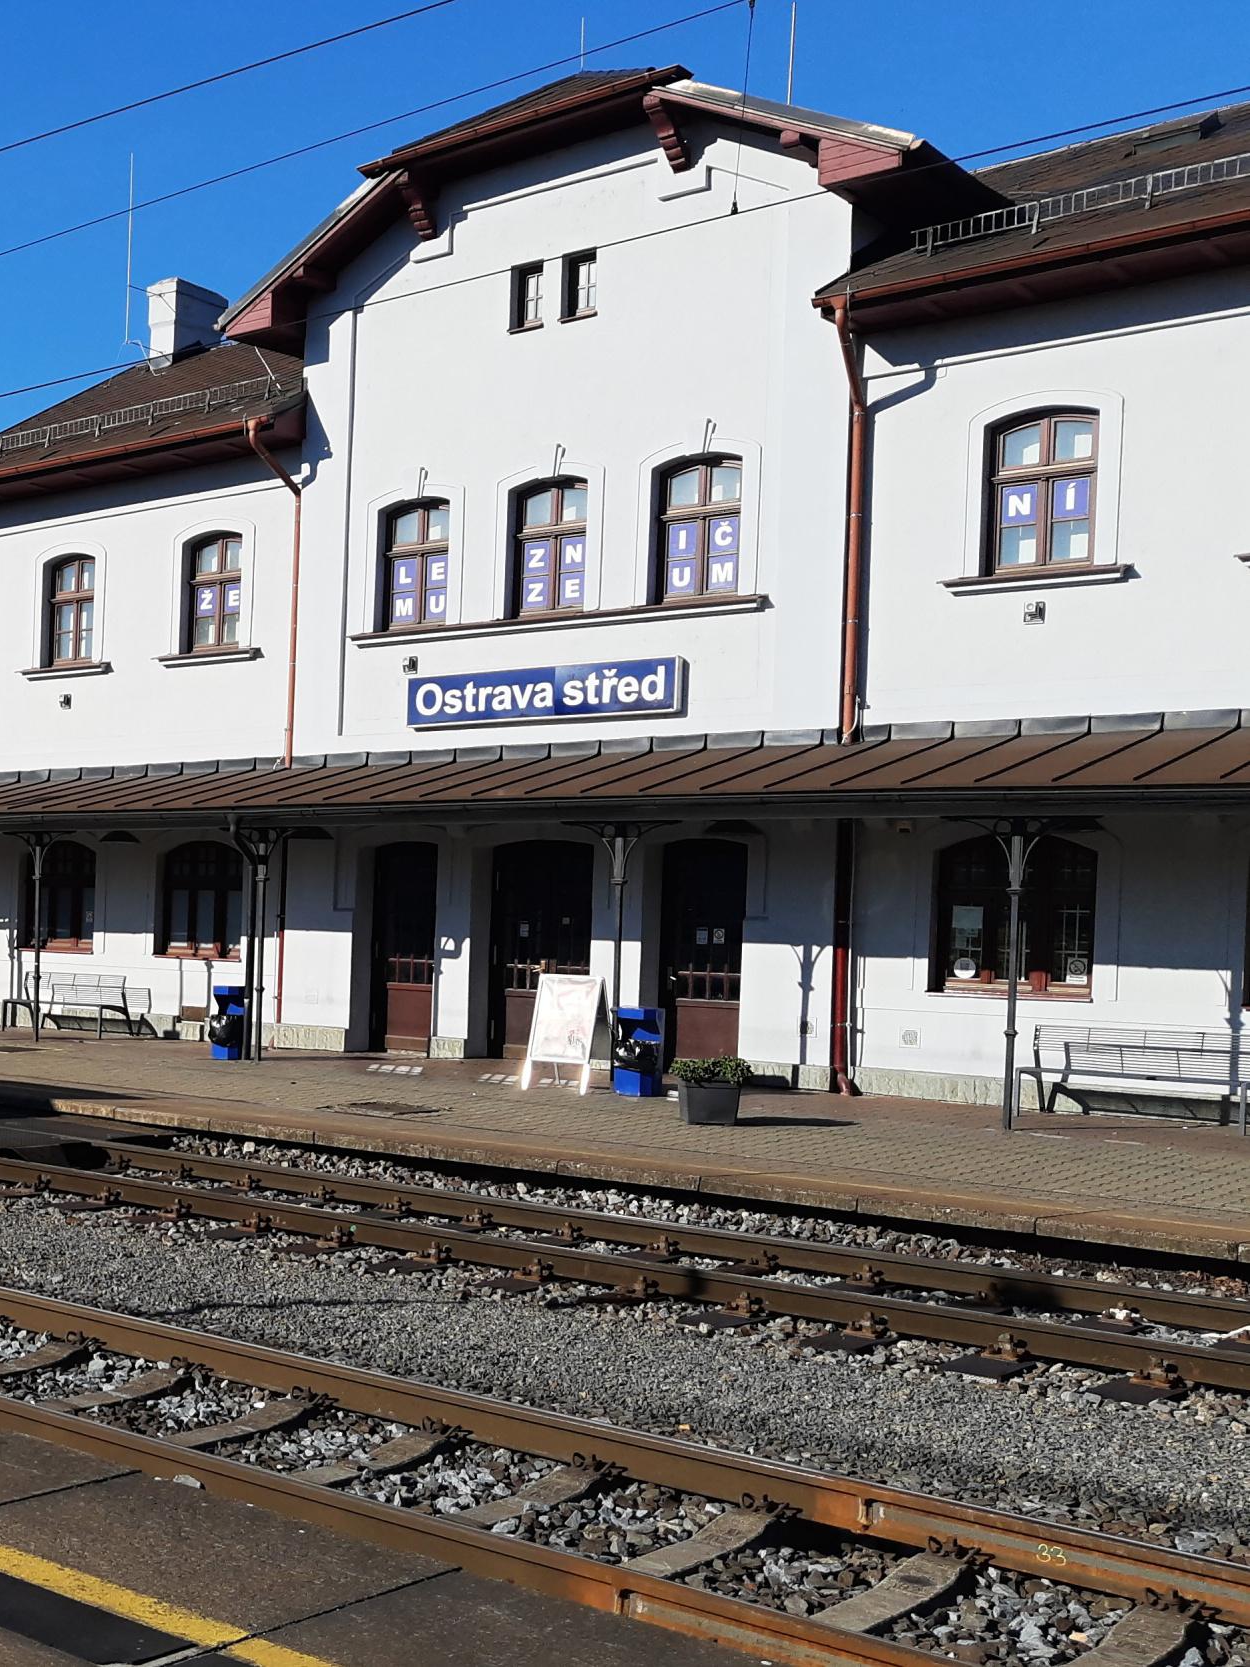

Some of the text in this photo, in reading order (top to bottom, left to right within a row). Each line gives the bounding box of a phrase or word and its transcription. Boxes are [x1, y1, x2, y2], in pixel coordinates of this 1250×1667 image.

[415, 665, 666, 716] Ostrava střed
[1036, 1543, 1067, 1567] 33
